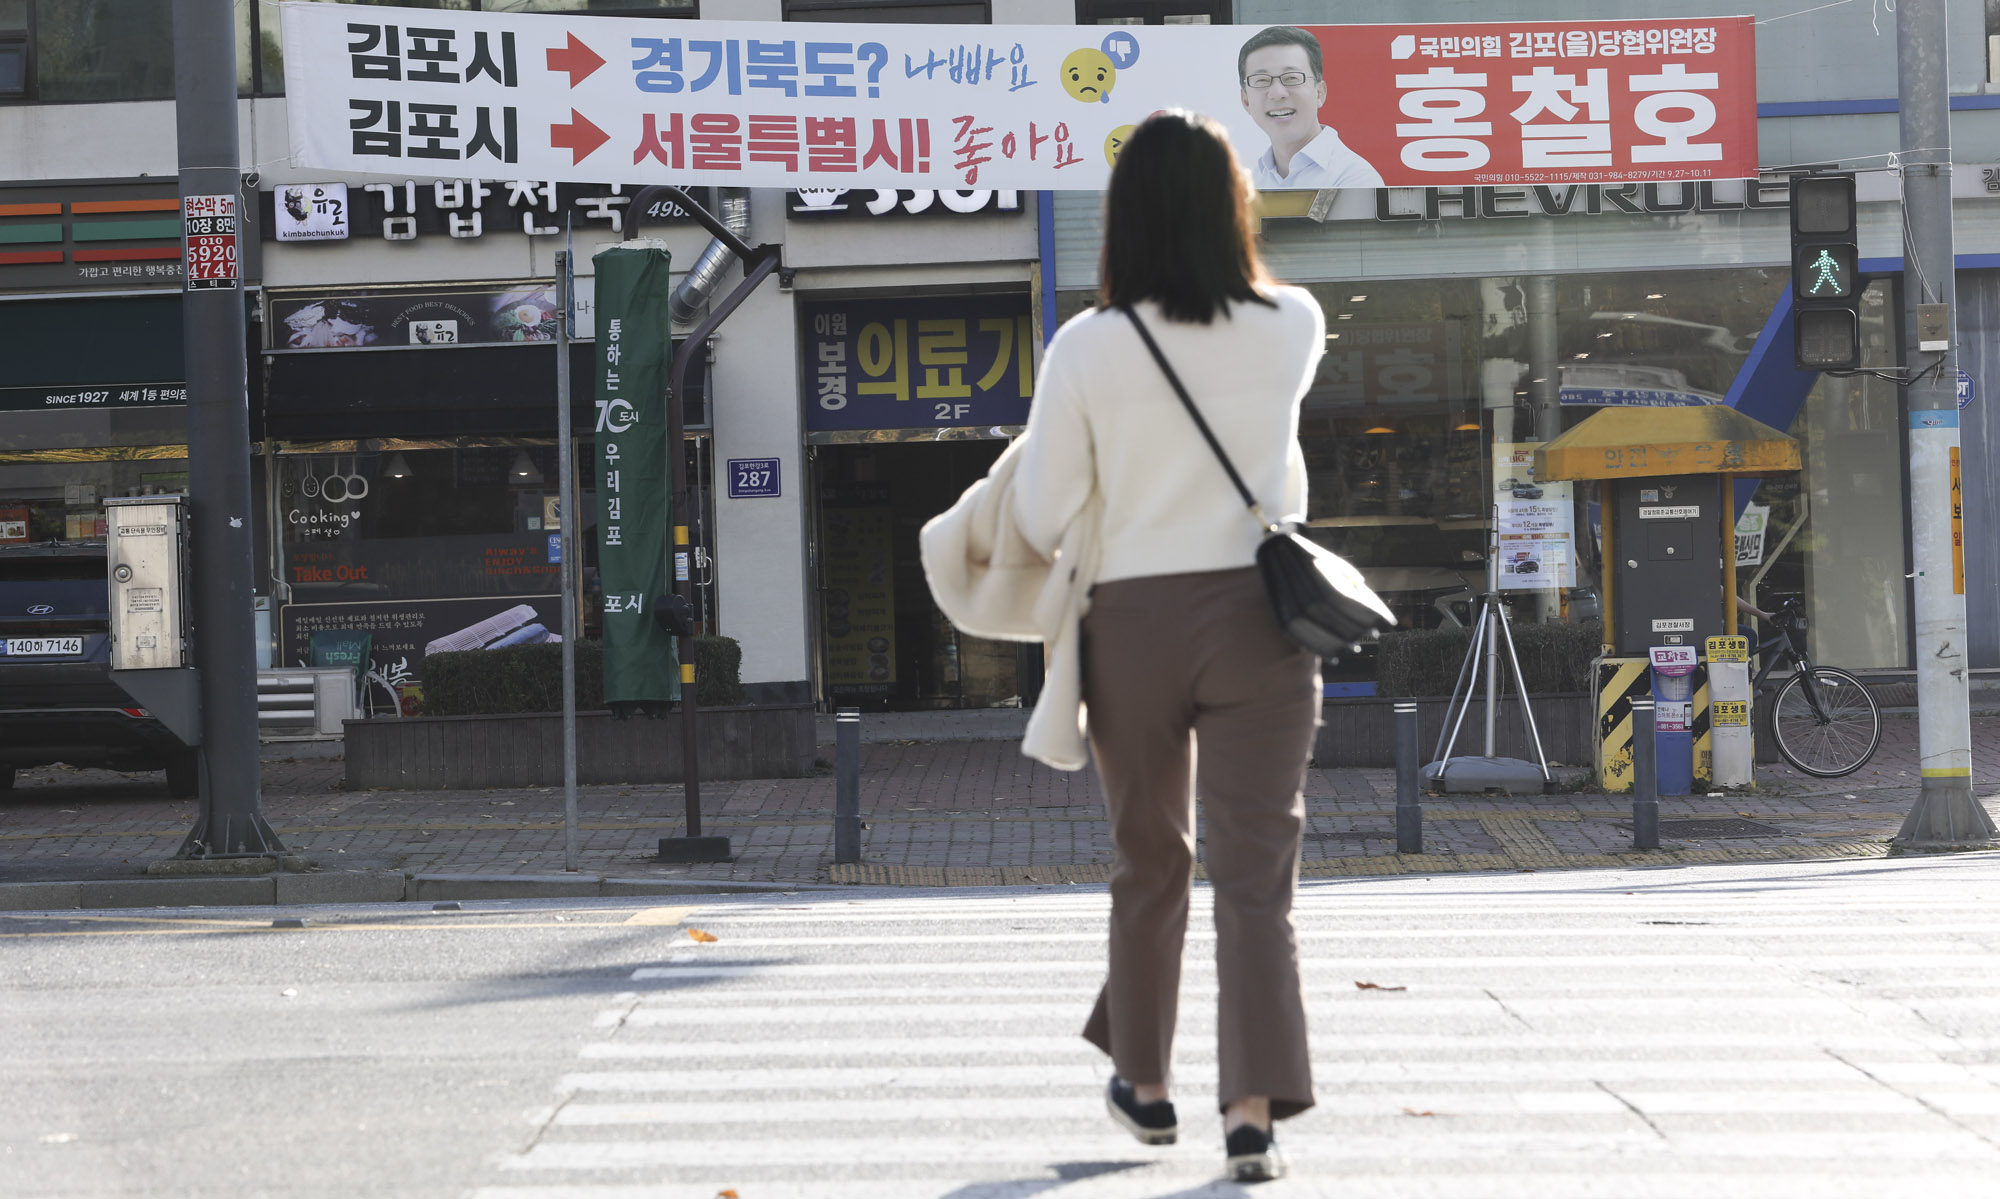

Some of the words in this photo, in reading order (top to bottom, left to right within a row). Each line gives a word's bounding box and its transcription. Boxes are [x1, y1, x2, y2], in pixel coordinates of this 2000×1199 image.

[1419, 36, 1501, 58] 국민의힘
[1509, 27, 1717, 58] 김포(을)당협위원장
[347, 23, 517, 88] 김포시
[631, 37, 888, 99] 경기북도?
[905, 43, 1038, 93] 나빠요
[1395, 63, 1723, 172] 홍철호
[349, 99, 518, 163] 김포시
[633, 113, 930, 173] 서울특별시!
[952, 115, 1083, 185] 좋아요
[1474, 173, 1504, 182] 국민의힘
[1667, 168, 1711, 178] 9.27~10.11
[185, 197, 216, 216] 현수막
[220, 198, 235, 214] 5m
[364, 178, 631, 240] 김밥천국
[187, 218, 212, 233] 10장
[216, 217, 235, 232] 8만
[283, 229, 345, 238] kimbabchunkuk
[200, 237, 223, 245] 010
[188, 245, 236, 262] 5920
[79, 267, 109, 278] 가깝고
[112, 266, 142, 277] 편리한
[189, 262, 237, 278] 4747
[814, 313, 847, 336] 이원
[606, 319, 621, 390] 통하는
[857, 316, 1032, 401] 의료기
[818, 341, 847, 411] 보경
[46, 395, 77, 404] SINCE
[77, 391, 109, 403] 1927
[119, 390, 139, 401] 세계
[141, 388, 157, 401] 1등
[934, 403, 970, 420] 2F
[738, 471, 770, 487] 287
[289, 509, 349, 528] Cooking
[293, 565, 334, 582] Take
[336, 564, 368, 580] Out
[295, 616, 322, 624] 매일매일
[324, 615, 345, 623] 신선한
[10, 640, 43, 653] 140하
[46, 640, 79, 652] 7146
[325, 652, 360, 664] Fresh
